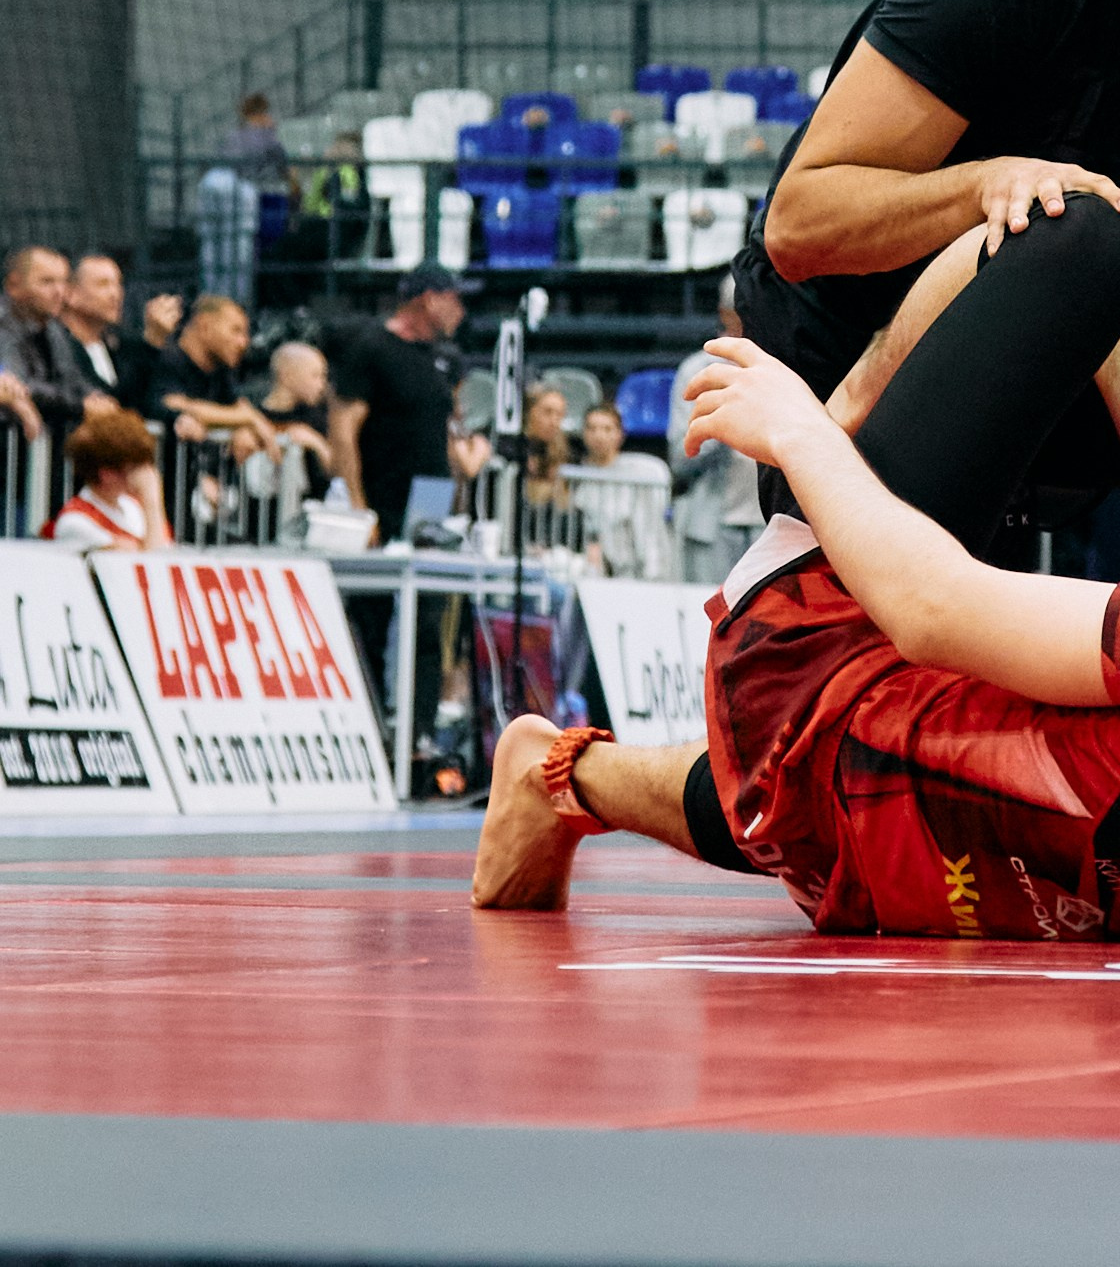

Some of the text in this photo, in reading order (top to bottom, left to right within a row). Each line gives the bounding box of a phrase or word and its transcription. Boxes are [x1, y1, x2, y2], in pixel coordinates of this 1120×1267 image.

[15, 594, 119, 711] Luta
[134, 564, 353, 701] LAPELA
[176, 709, 380, 804] championship
